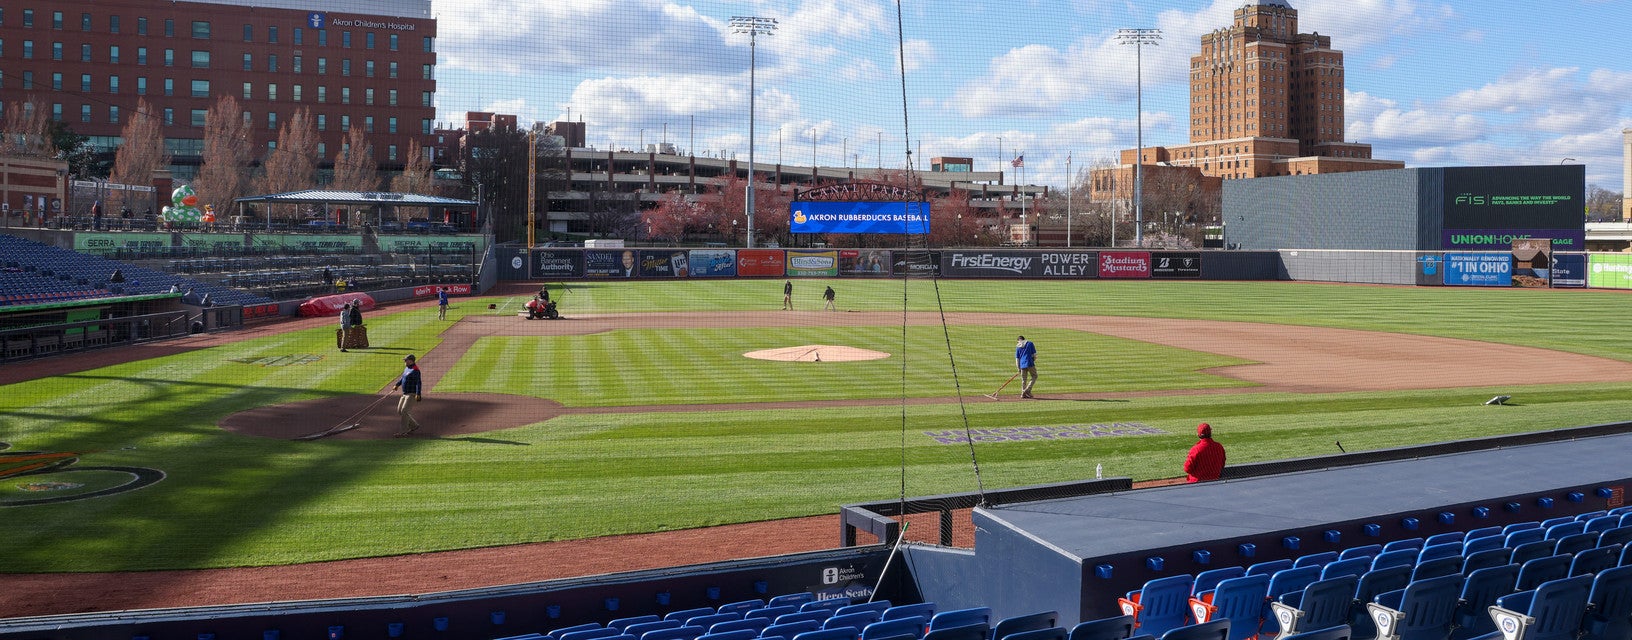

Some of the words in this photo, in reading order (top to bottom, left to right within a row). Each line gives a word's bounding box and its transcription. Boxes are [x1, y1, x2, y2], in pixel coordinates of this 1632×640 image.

[332, 18, 353, 27] Akron
[354, 19, 386, 29] Children's
[387, 22, 415, 31] Hospital
[808, 184, 860, 199] CANAL
[870, 184, 912, 199] PARK
[808, 214, 837, 222] AKRON
[838, 214, 892, 222] RUBBERDUCKS
[87, 239, 115, 247] SERRA
[540, 251, 555, 259] Ohio
[1041, 253, 1089, 264] POWER
[951, 253, 1032, 270] FirstEnergy
[1102, 255, 1147, 266] Stadium
[540, 263, 575, 271] Authority
[1043, 265, 1087, 275] ALLEY
[1102, 263, 1147, 272] Mustard
[1451, 262, 1463, 273] #1
[1465, 262, 1477, 273] IN
[1479, 262, 1509, 273] OHIO
[839, 573, 864, 581] Children's
[817, 592, 843, 602] Hero
[845, 588, 873, 598] Seats
